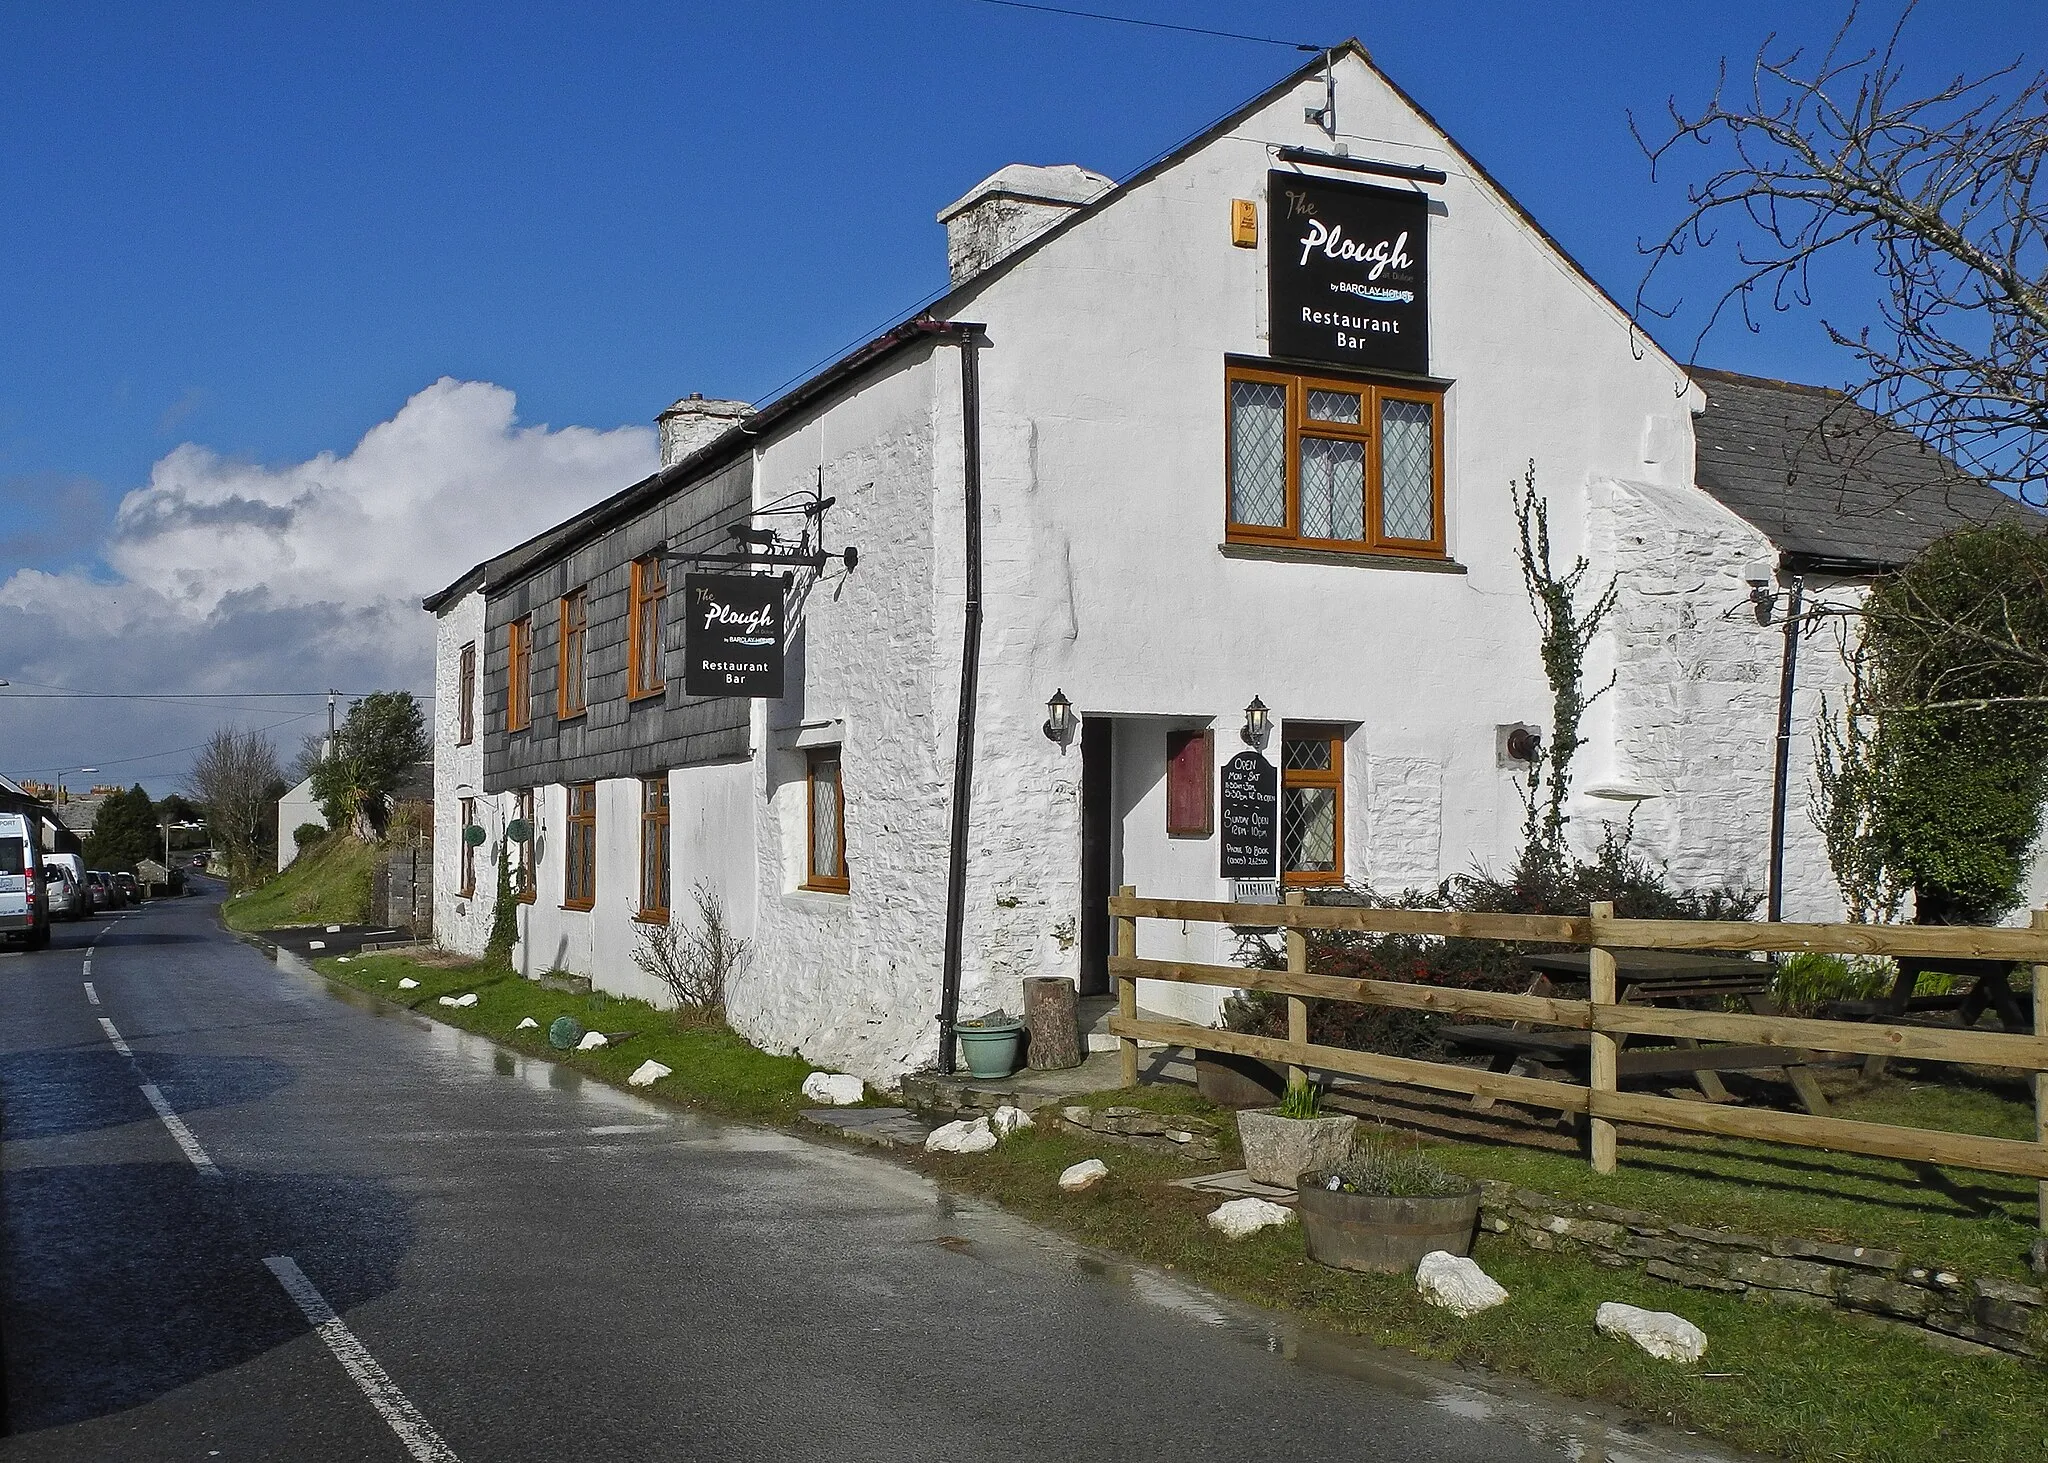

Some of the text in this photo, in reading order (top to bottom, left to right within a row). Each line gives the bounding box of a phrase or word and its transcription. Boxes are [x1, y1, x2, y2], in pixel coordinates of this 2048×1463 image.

[1285, 190, 1318, 219] The
[1299, 218, 1413, 281] Plough
[1330, 282, 1414, 301] by BARCLAY HOUSE
[1302, 306, 1400, 334] Restaurant
[1337, 332, 1366, 350] Bar
[695, 587, 716, 605] The
[704, 602, 774, 634] Plough
[702, 660, 769, 672] Restaurant
[725, 674, 746, 684] Bar
[1234, 757, 1257, 771] OPEN
[1244, 845, 1252, 855] TO
[1253, 845, 1270, 857] BOOK
